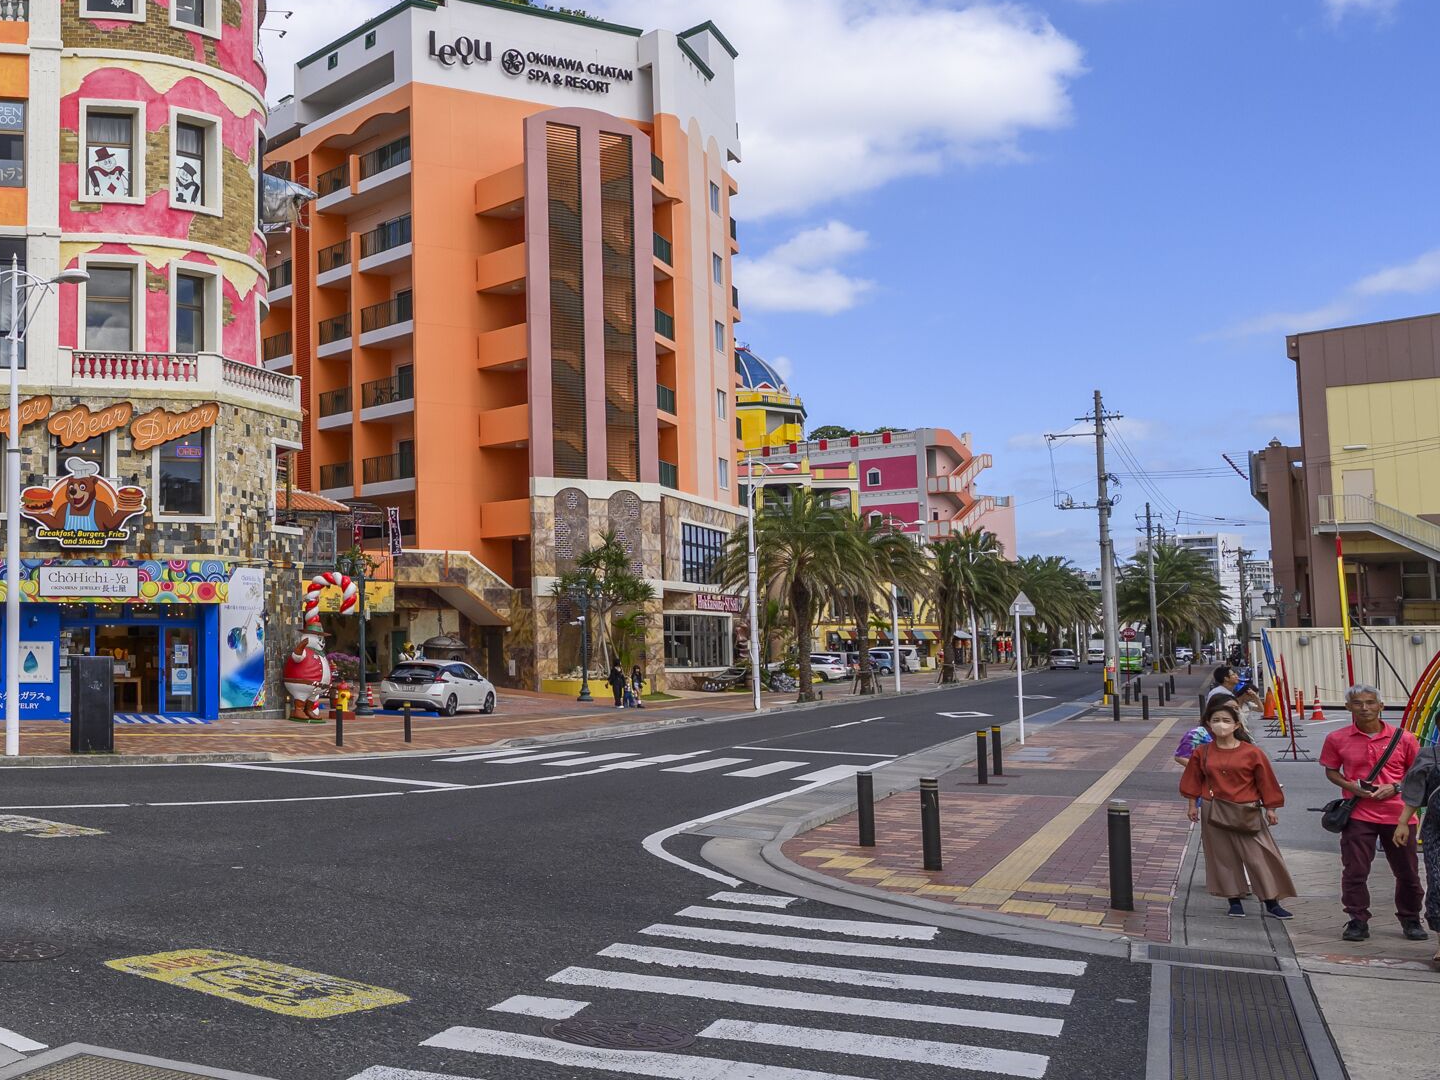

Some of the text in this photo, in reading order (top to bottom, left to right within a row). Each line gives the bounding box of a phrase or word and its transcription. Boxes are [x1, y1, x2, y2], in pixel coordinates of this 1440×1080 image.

[526, 51, 633, 81] OKINAWA CHATAN
[528, 69, 611, 94] SPA & RESORT
[53, 408, 128, 439] Bear
[136, 408, 215, 445] Diner
[178, 447, 201, 456] OPEN
[39, 529, 76, 538] Breakfast,
[77, 530, 107, 538] Burgers,
[102, 585, 127, 593] 長七屋
